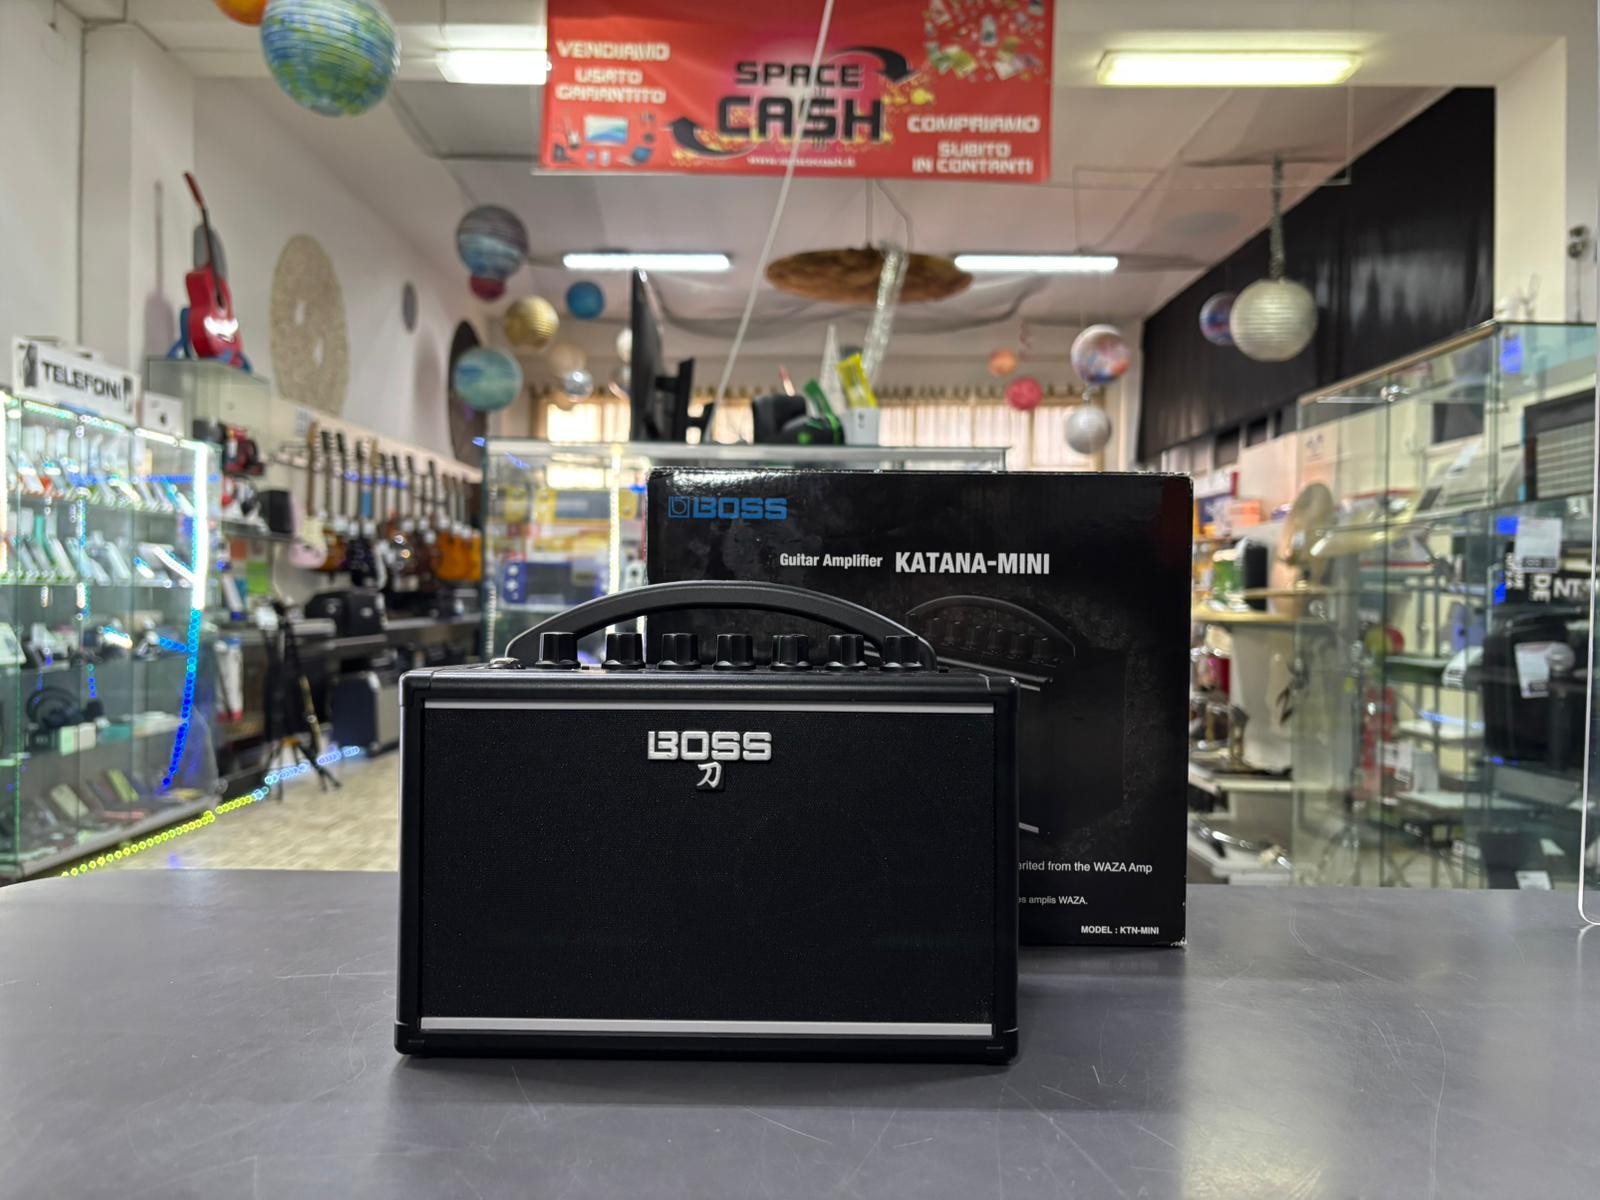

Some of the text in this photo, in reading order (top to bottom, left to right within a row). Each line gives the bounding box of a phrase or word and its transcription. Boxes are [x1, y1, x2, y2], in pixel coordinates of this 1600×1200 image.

[556, 41, 671, 61] VENDIAMO
[574, 68, 643, 84] USATO
[735, 61, 861, 88] SPACE
[555, 85, 667, 104] GARANTITO
[718, 96, 882, 142] CASH
[907, 115, 1041, 133] COMPRIAMO
[937, 141, 1011, 158] SUBITO
[912, 157, 1034, 175] IN CONTANTI
[41, 361, 122, 400] TELEFONI
[693, 497, 787, 520] BOSS
[779, 551, 1050, 575] Guitar Amplifier KATANA-MINI
[648, 731, 772, 761] BOSS
[1048, 861, 1072, 871] from
[1074, 861, 1091, 871] the
[1093, 862, 1127, 872] WAZA
[1128, 862, 1153, 875] Amp
[1058, 895, 1088, 904] WAZA.
[1081, 925, 1113, 934] MODEL
[1119, 926, 1160, 935] KTN-MINI
